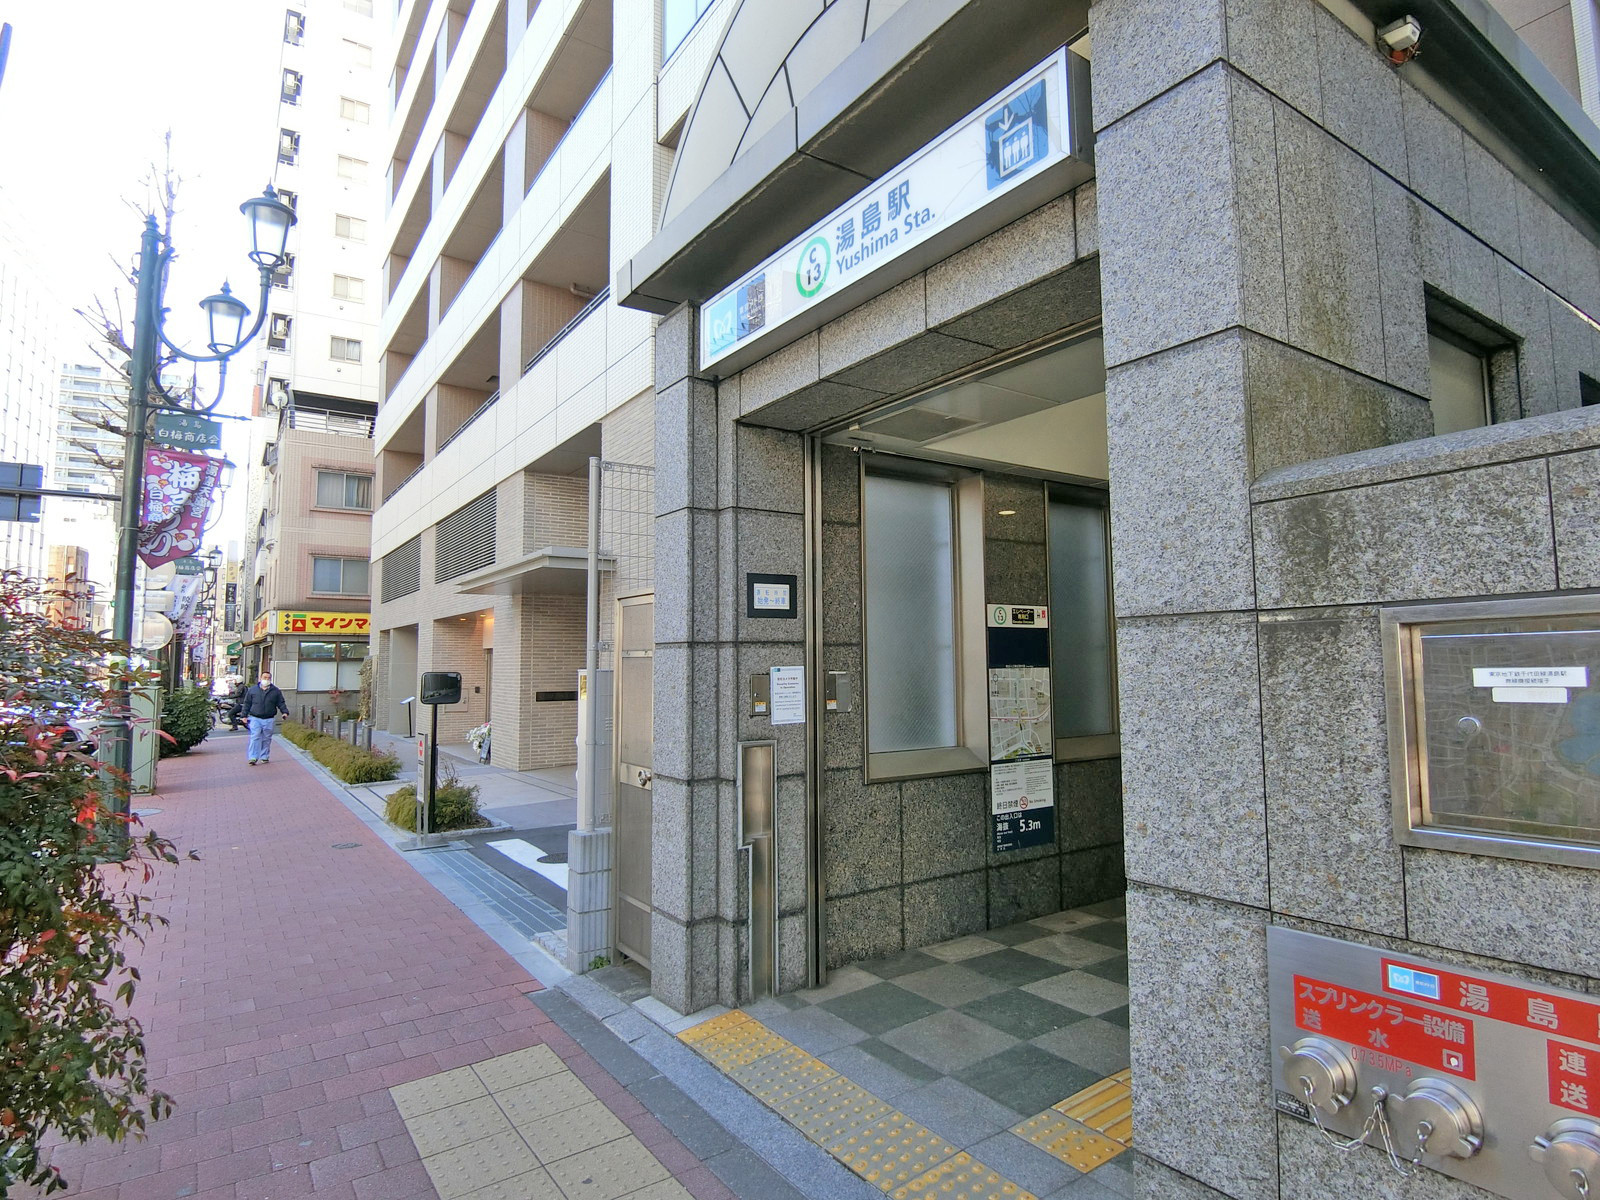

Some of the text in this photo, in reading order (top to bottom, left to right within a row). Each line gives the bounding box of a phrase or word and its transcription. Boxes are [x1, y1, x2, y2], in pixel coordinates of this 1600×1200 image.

[836, 178, 911, 256] 湯島駅
[836, 207, 936, 276] Yushima Sta.
[809, 247, 817, 264] C
[806, 263, 822, 286] 13
[158, 428, 220, 445] 白梅商店会
[310, 617, 371, 630] マインマ
[1019, 819, 1041, 833] 5.3m
[1299, 981, 1466, 1045] スプリンクラー設備
